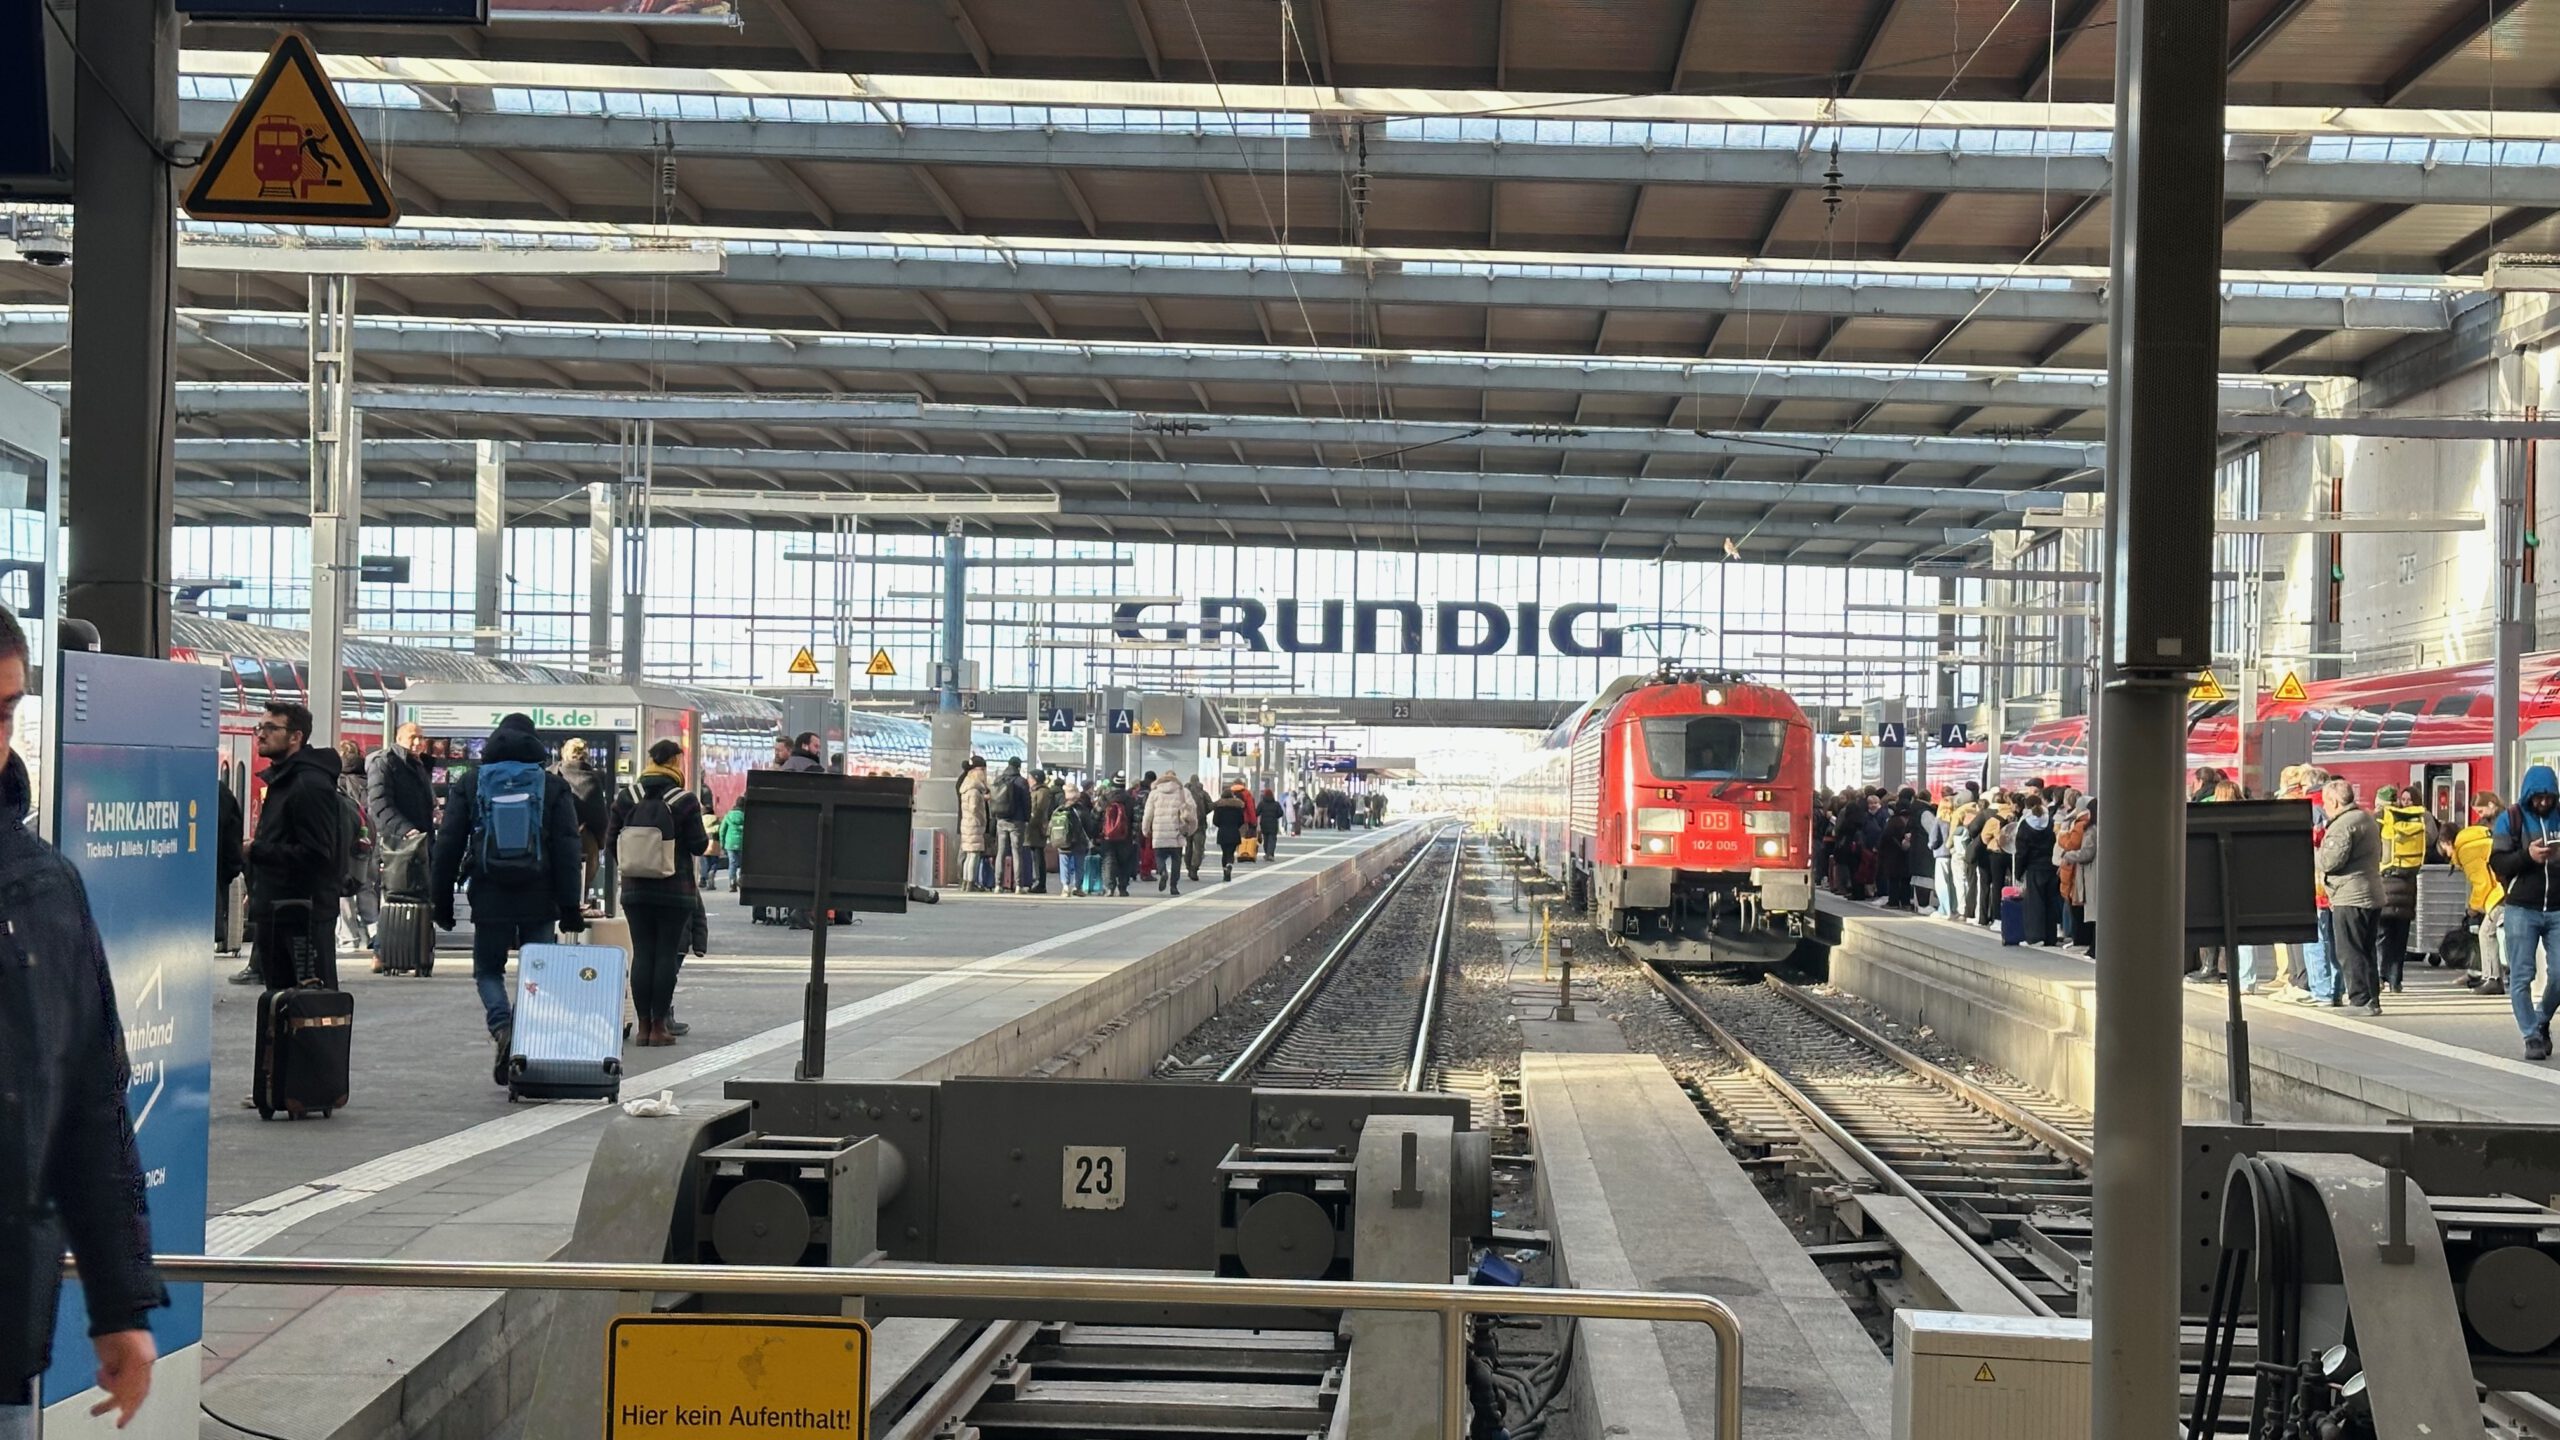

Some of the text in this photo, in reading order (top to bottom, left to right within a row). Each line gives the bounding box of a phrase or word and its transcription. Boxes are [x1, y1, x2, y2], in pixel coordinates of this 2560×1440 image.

[1114, 598, 1623, 657] GRUNDIG
[491, 708, 592, 726] zlls.de
[1052, 709, 1067, 727] A
[1116, 710, 1130, 728] A
[1394, 706, 1409, 718] 23
[1882, 723, 1897, 742] A
[1948, 724, 1963, 743] A
[1236, 742, 1245, 755] B
[1307, 760, 1315, 769] C
[86, 801, 179, 832] FAHRKARTEN
[1702, 813, 1728, 828] DB
[86, 842, 113, 858] Tickets
[121, 840, 143, 856] Billets
[151, 838, 178, 858] Biglietti
[1692, 841, 1738, 851] 102 005
[1076, 1156, 1113, 1194] 23
[622, 1405, 851, 1430] Hier kein Aufenthalt!
